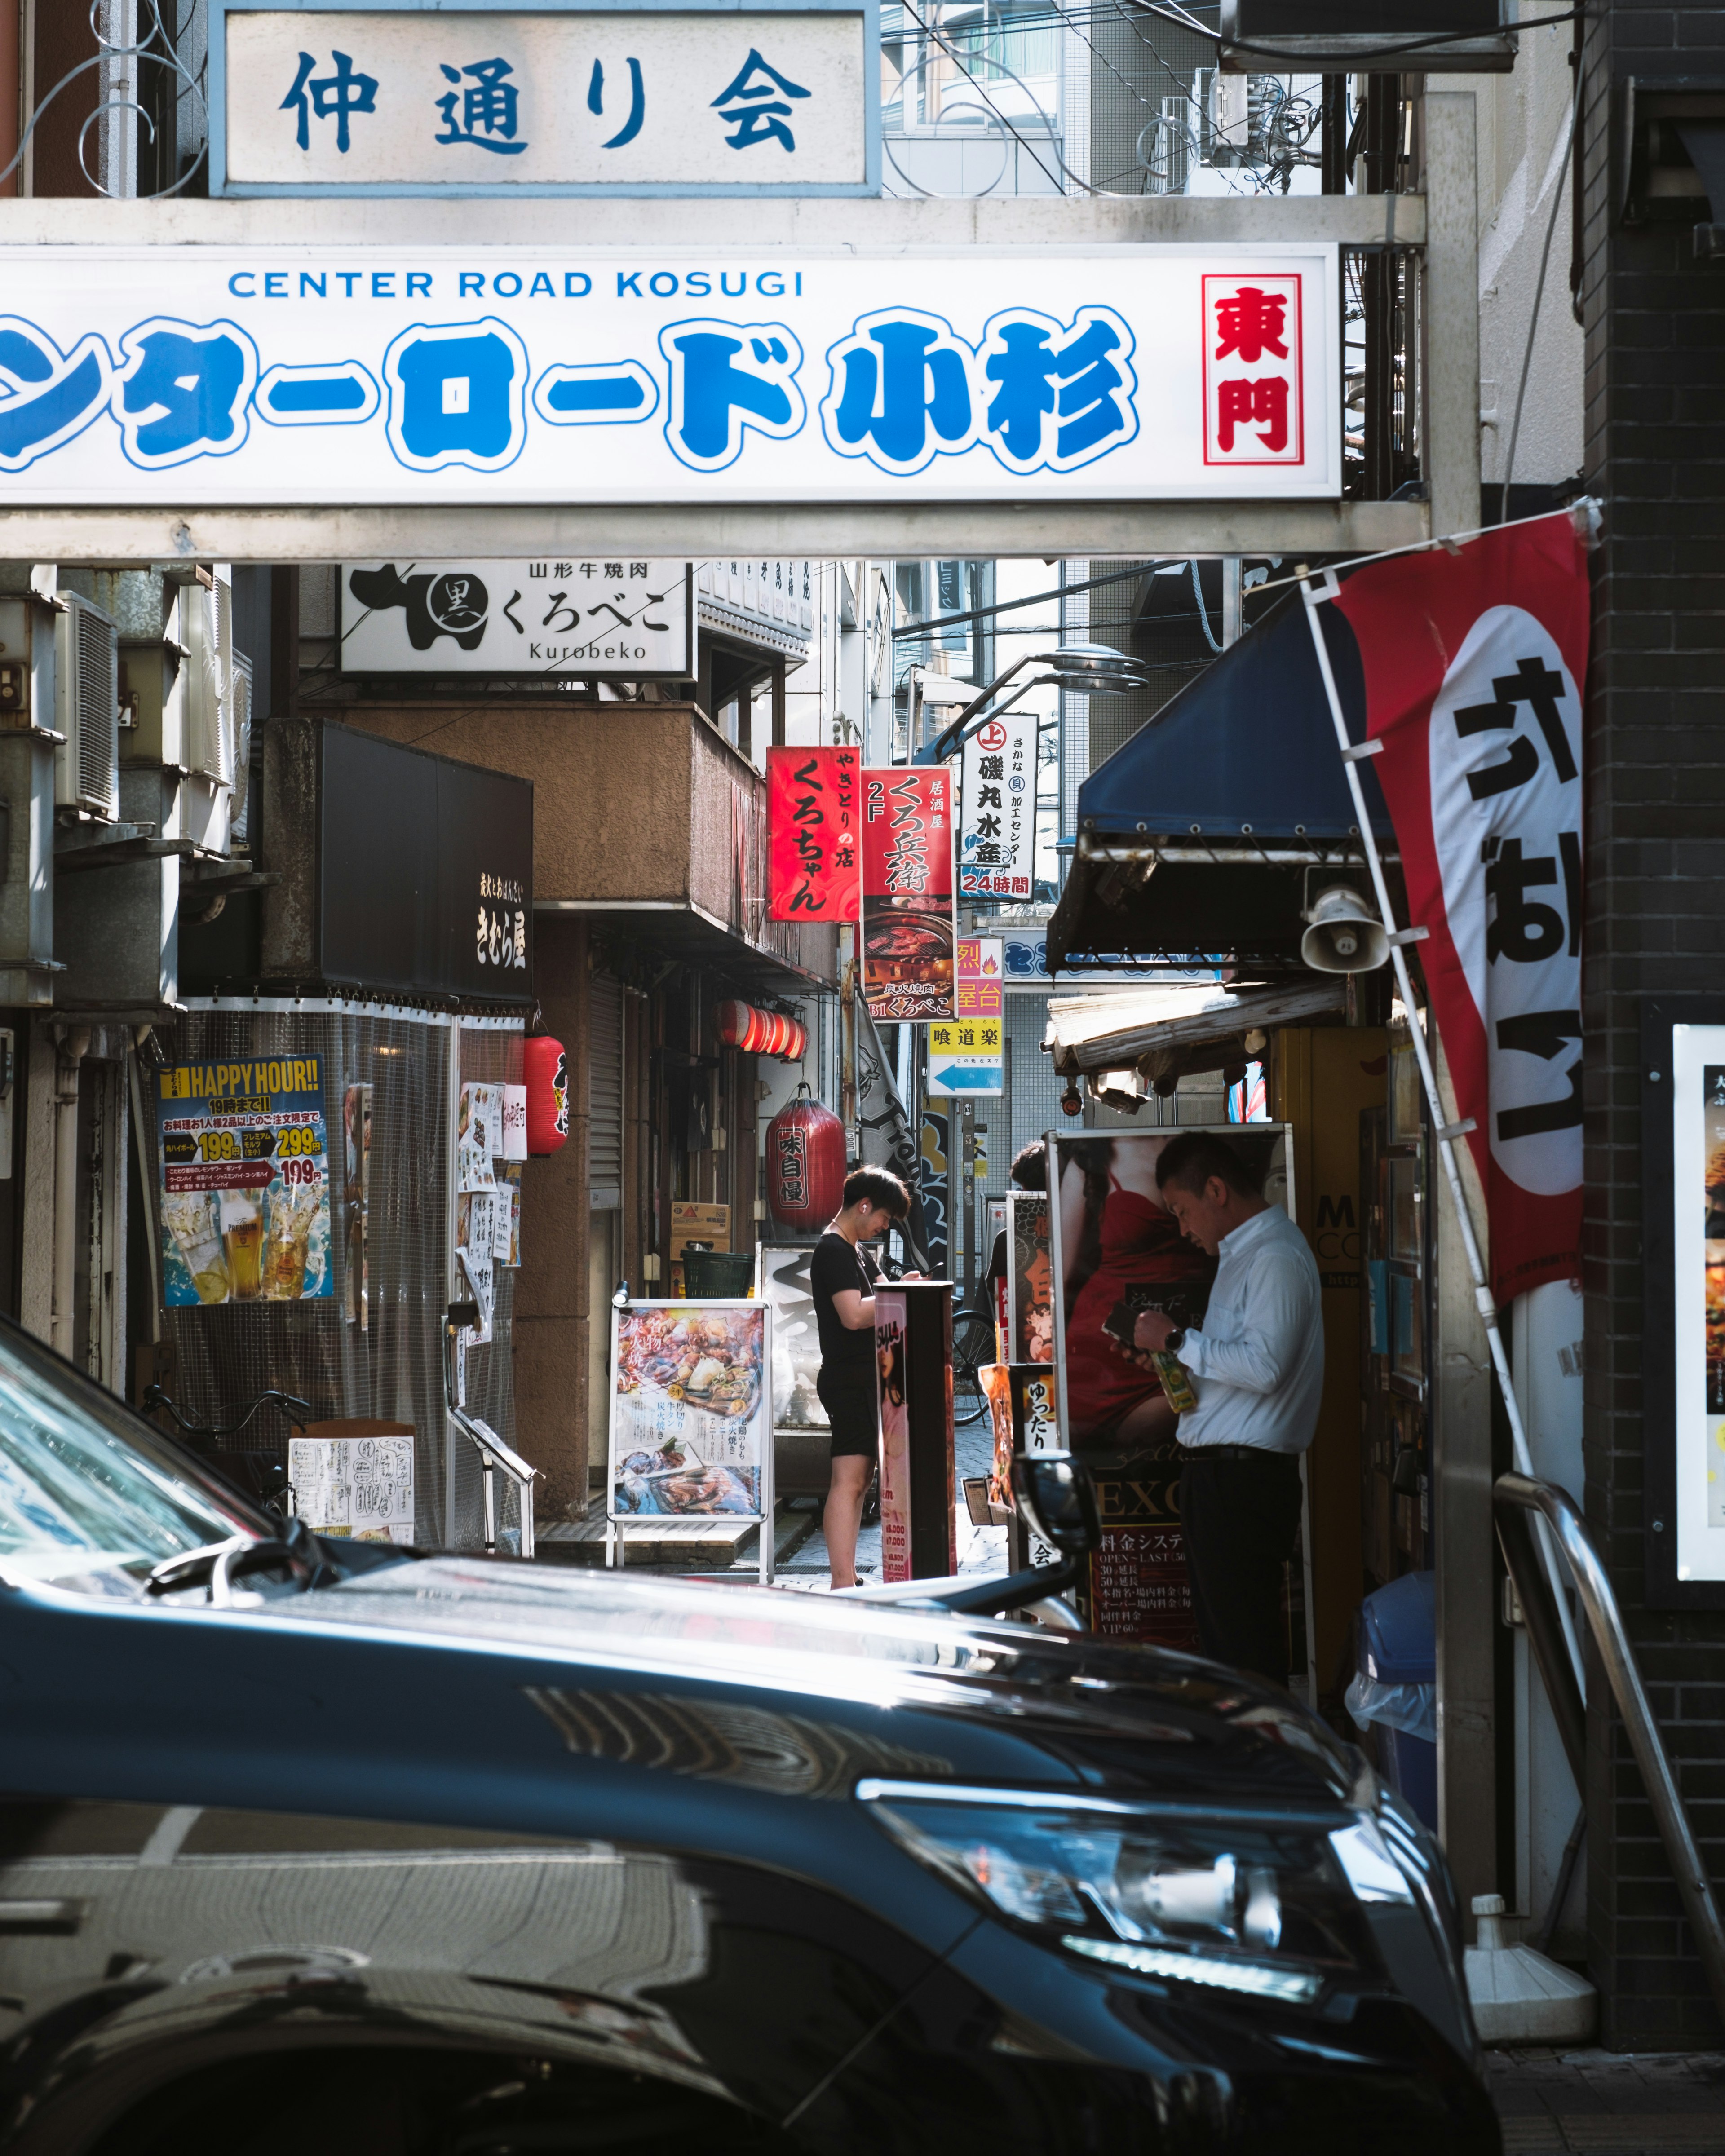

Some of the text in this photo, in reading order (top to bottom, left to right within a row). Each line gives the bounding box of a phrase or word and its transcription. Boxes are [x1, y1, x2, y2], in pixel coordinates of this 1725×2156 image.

[281, 48, 812, 154] 仲通り会
[228, 272, 804, 298] CENTER ROAD KOSUGI
[1215, 287, 1289, 452] 東門
[503, 589, 669, 634] くろべこ
[530, 643, 646, 659] Kurobeko
[835, 753, 854, 868] やきとりの店
[929, 780, 945, 829] 居酒屋
[976, 755, 1004, 865] 磯丸水産
[789, 759, 827, 912] くろちゃん
[962, 876, 1029, 894] 24時間
[477, 906, 526, 969] きむら屋
[887, 997, 951, 1017] くろべこ
[958, 984, 1001, 1008] 屋台
[934, 1028, 998, 1046] 喰道楽
[191, 1063, 253, 1097] HAPPY
[257, 1059, 319, 1094] HOUR!!
[209, 1096, 271, 1115] 19時まで!!
[163, 1112, 321, 1132] お料理お1人様2品以上のご注文限定で
[198, 1131, 240, 1162] 199円
[277, 1127, 321, 1158] 299円
[280, 1159, 322, 1186] 199円
[779, 1133, 804, 1202] 味自慢
[228, 1223, 257, 1232] PREMIUM
[646, 1318, 662, 1350] 名物
[628, 1318, 644, 1384] 炭火焼き
[1099, 1534, 1183, 1553] 料金システ
